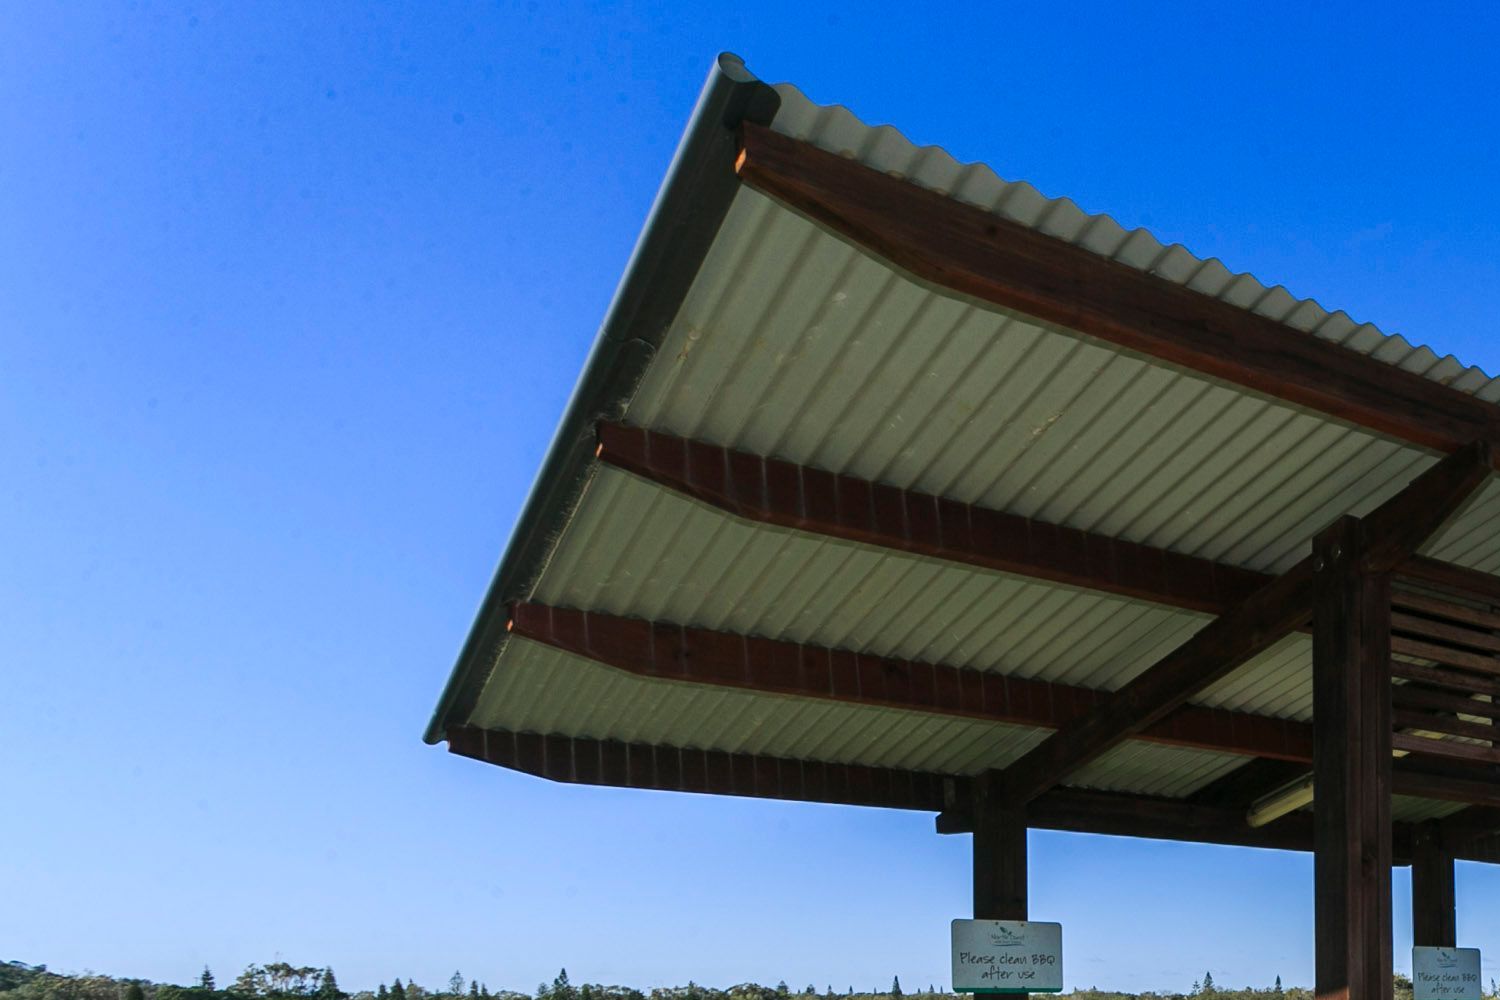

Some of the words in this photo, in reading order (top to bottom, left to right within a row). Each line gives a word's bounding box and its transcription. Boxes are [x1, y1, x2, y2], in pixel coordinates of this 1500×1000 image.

[960, 952, 995, 965] Please
[1000, 952, 1027, 965] clean
[1031, 954, 1056, 966] BBQ
[981, 965, 1013, 980] after
[1017, 971, 1035, 980] use
[1417, 972, 1440, 982] Please
[1442, 972, 1460, 982] clean
[1462, 973, 1478, 982] BBQ
[1431, 982, 1450, 994] after
